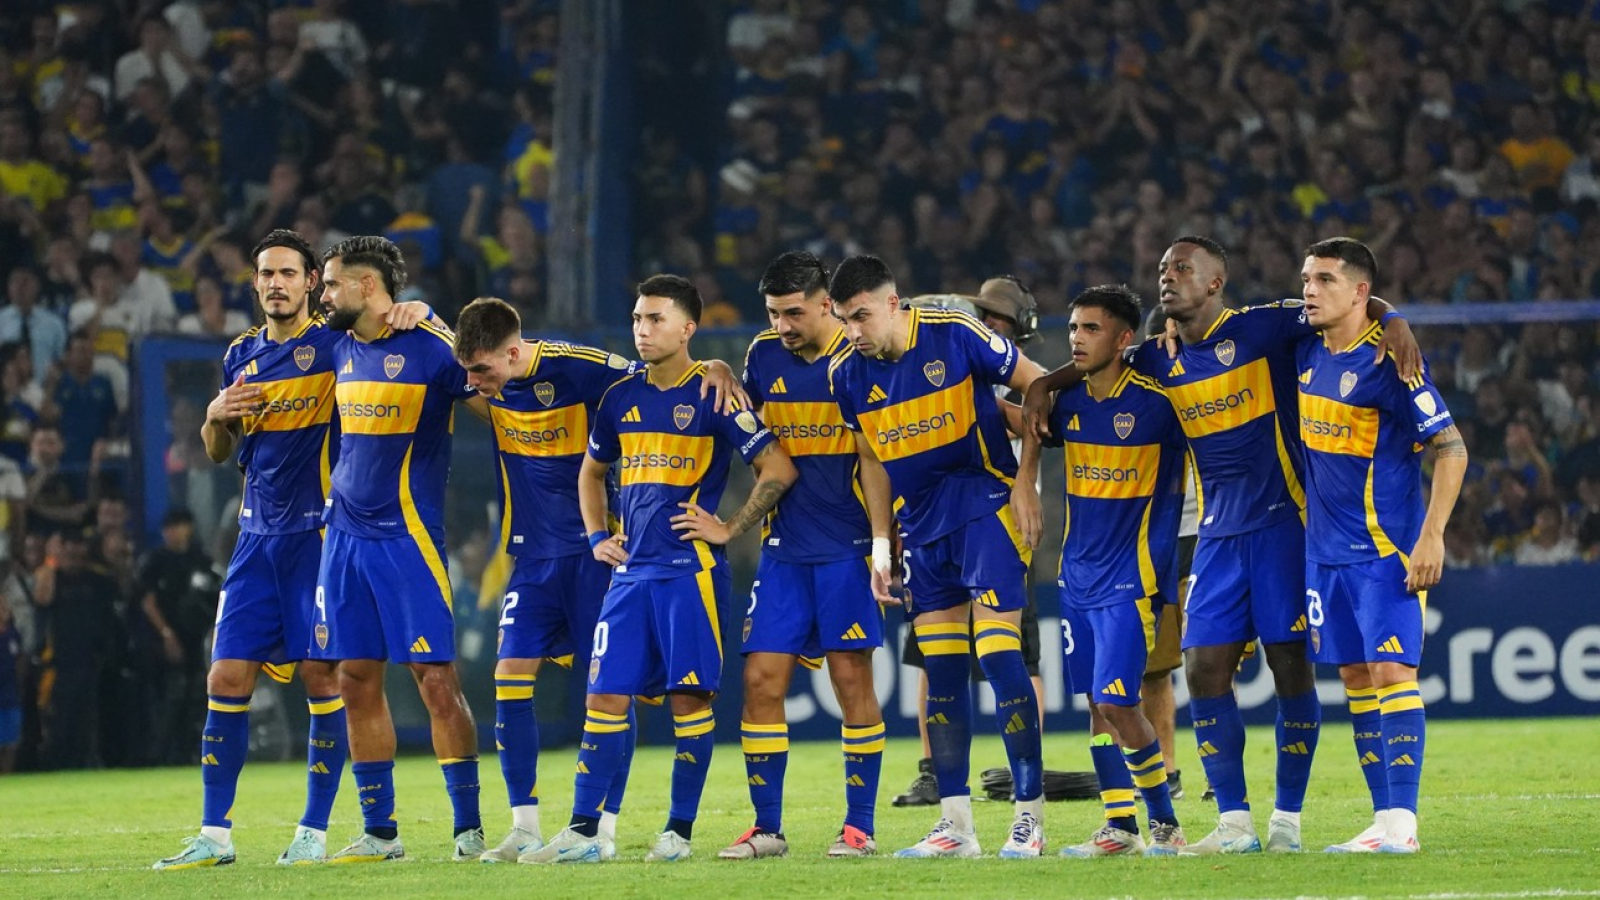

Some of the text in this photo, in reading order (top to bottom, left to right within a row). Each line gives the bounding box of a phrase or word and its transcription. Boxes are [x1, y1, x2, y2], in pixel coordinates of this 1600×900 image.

[251, 395, 318, 416] etsson
[337, 401, 400, 418] etsson
[772, 421, 844, 440] betsson
[877, 411, 956, 445] betsson
[1301, 415, 1352, 438] tsson
[622, 452, 696, 470] betsson
[315, 586, 326, 621] 9
[1193, 717, 1216, 728] ABJ
